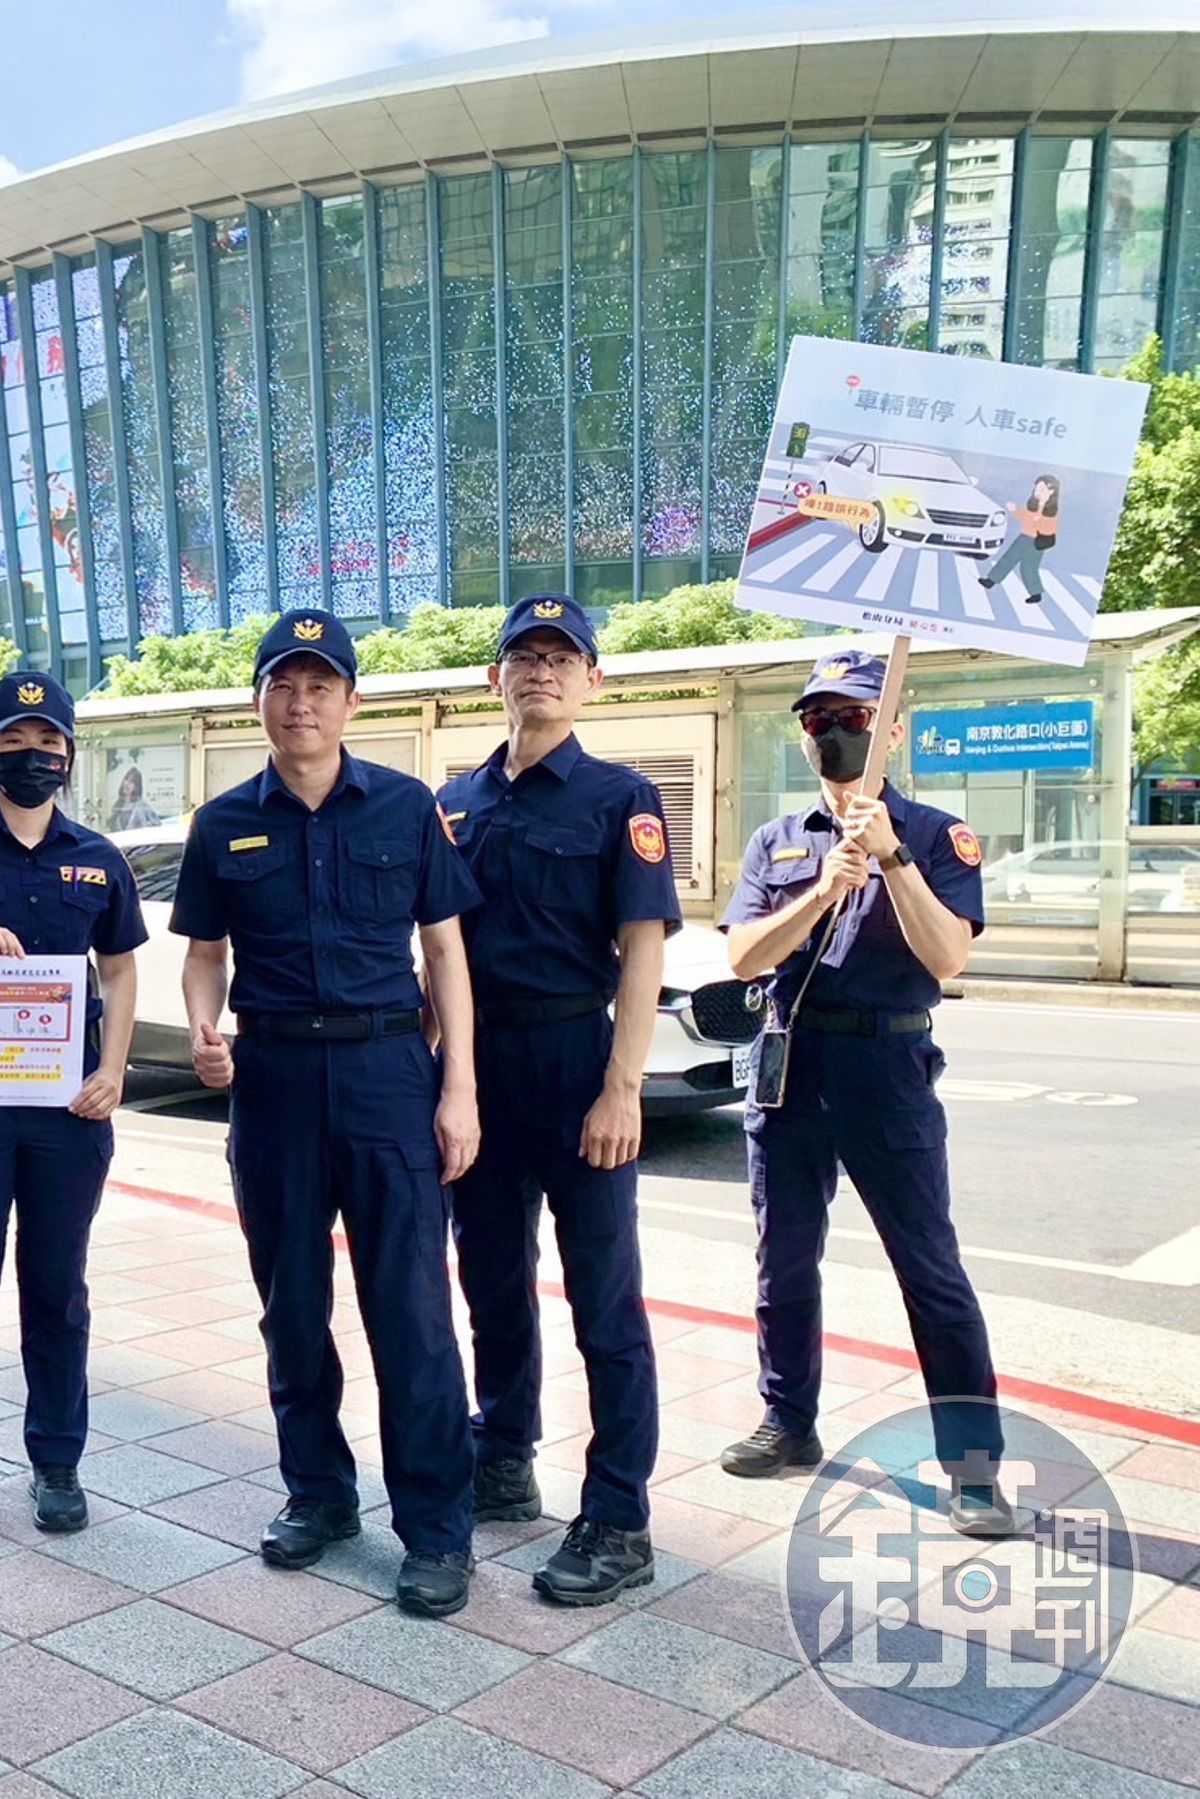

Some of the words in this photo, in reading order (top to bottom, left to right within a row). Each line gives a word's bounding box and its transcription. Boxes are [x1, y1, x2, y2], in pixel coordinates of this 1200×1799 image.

[854, 388, 955, 424] 車輛暫停
[965, 405, 1068, 439] 人車safe
